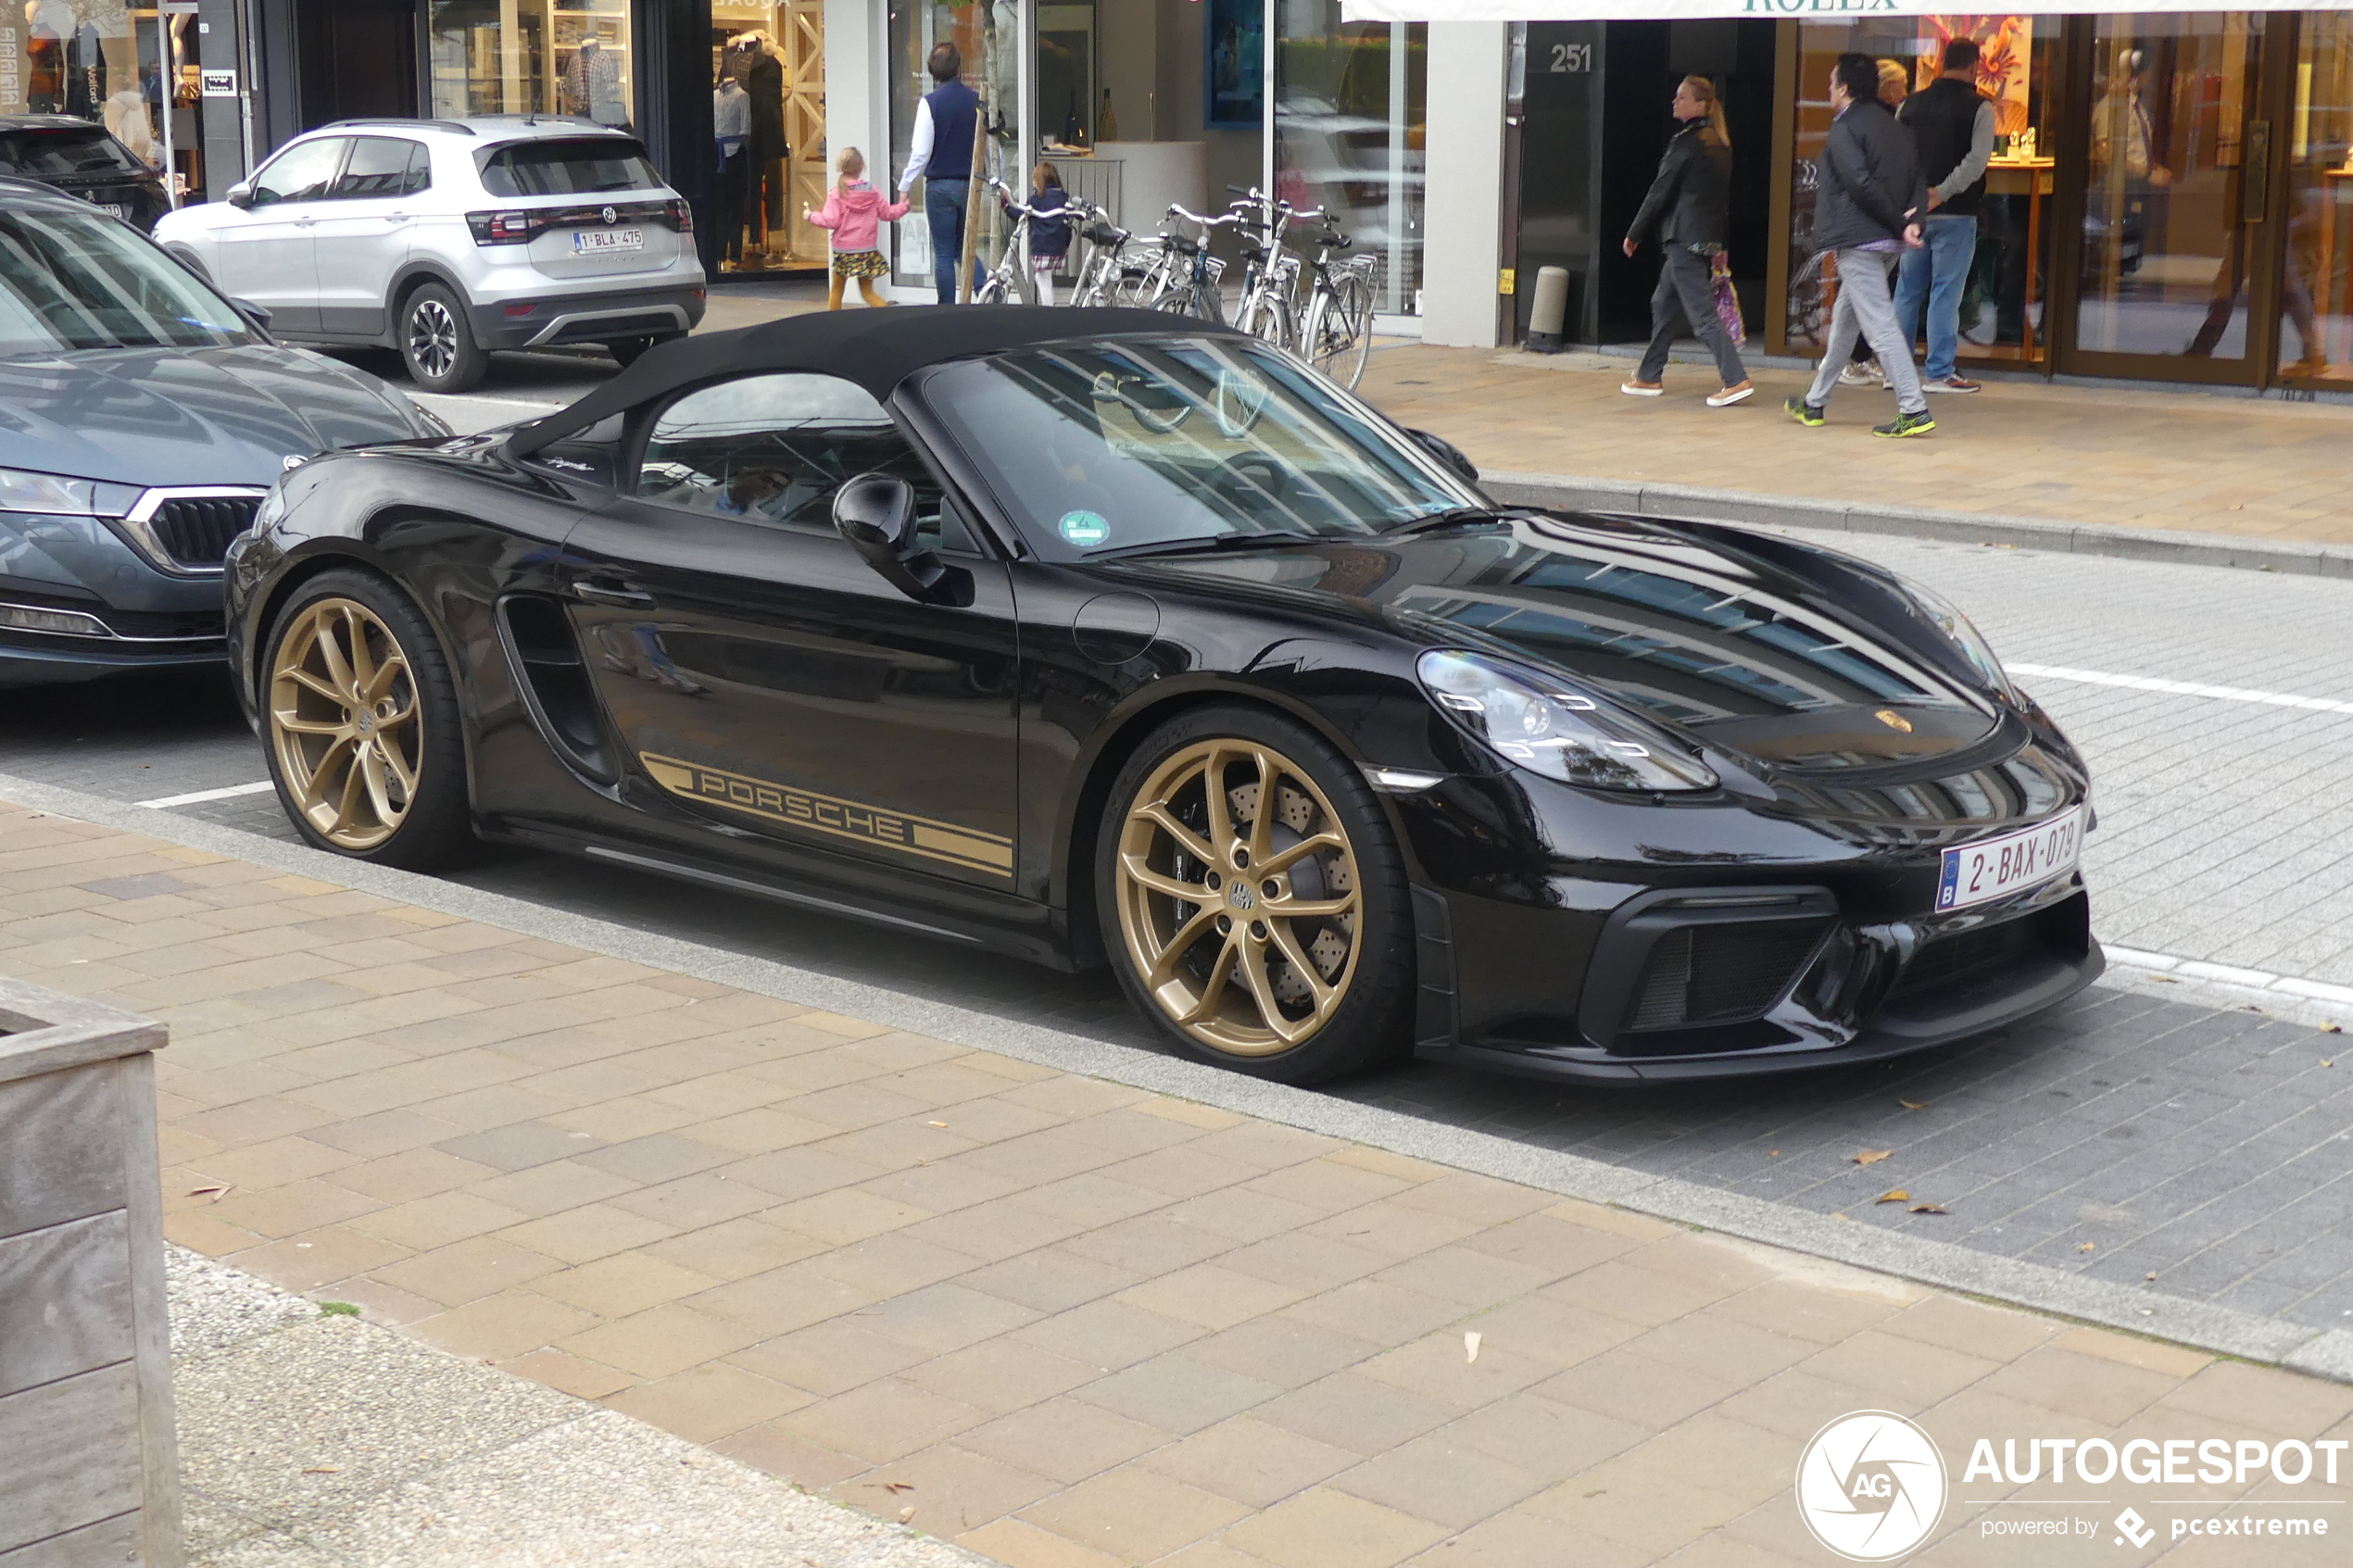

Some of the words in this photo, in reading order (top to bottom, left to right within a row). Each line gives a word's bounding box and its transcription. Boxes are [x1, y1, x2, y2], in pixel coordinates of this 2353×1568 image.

[1550, 44, 1591, 72] 251
[700, 772, 904, 842] PORSCHE
[1942, 885, 1954, 905] B
